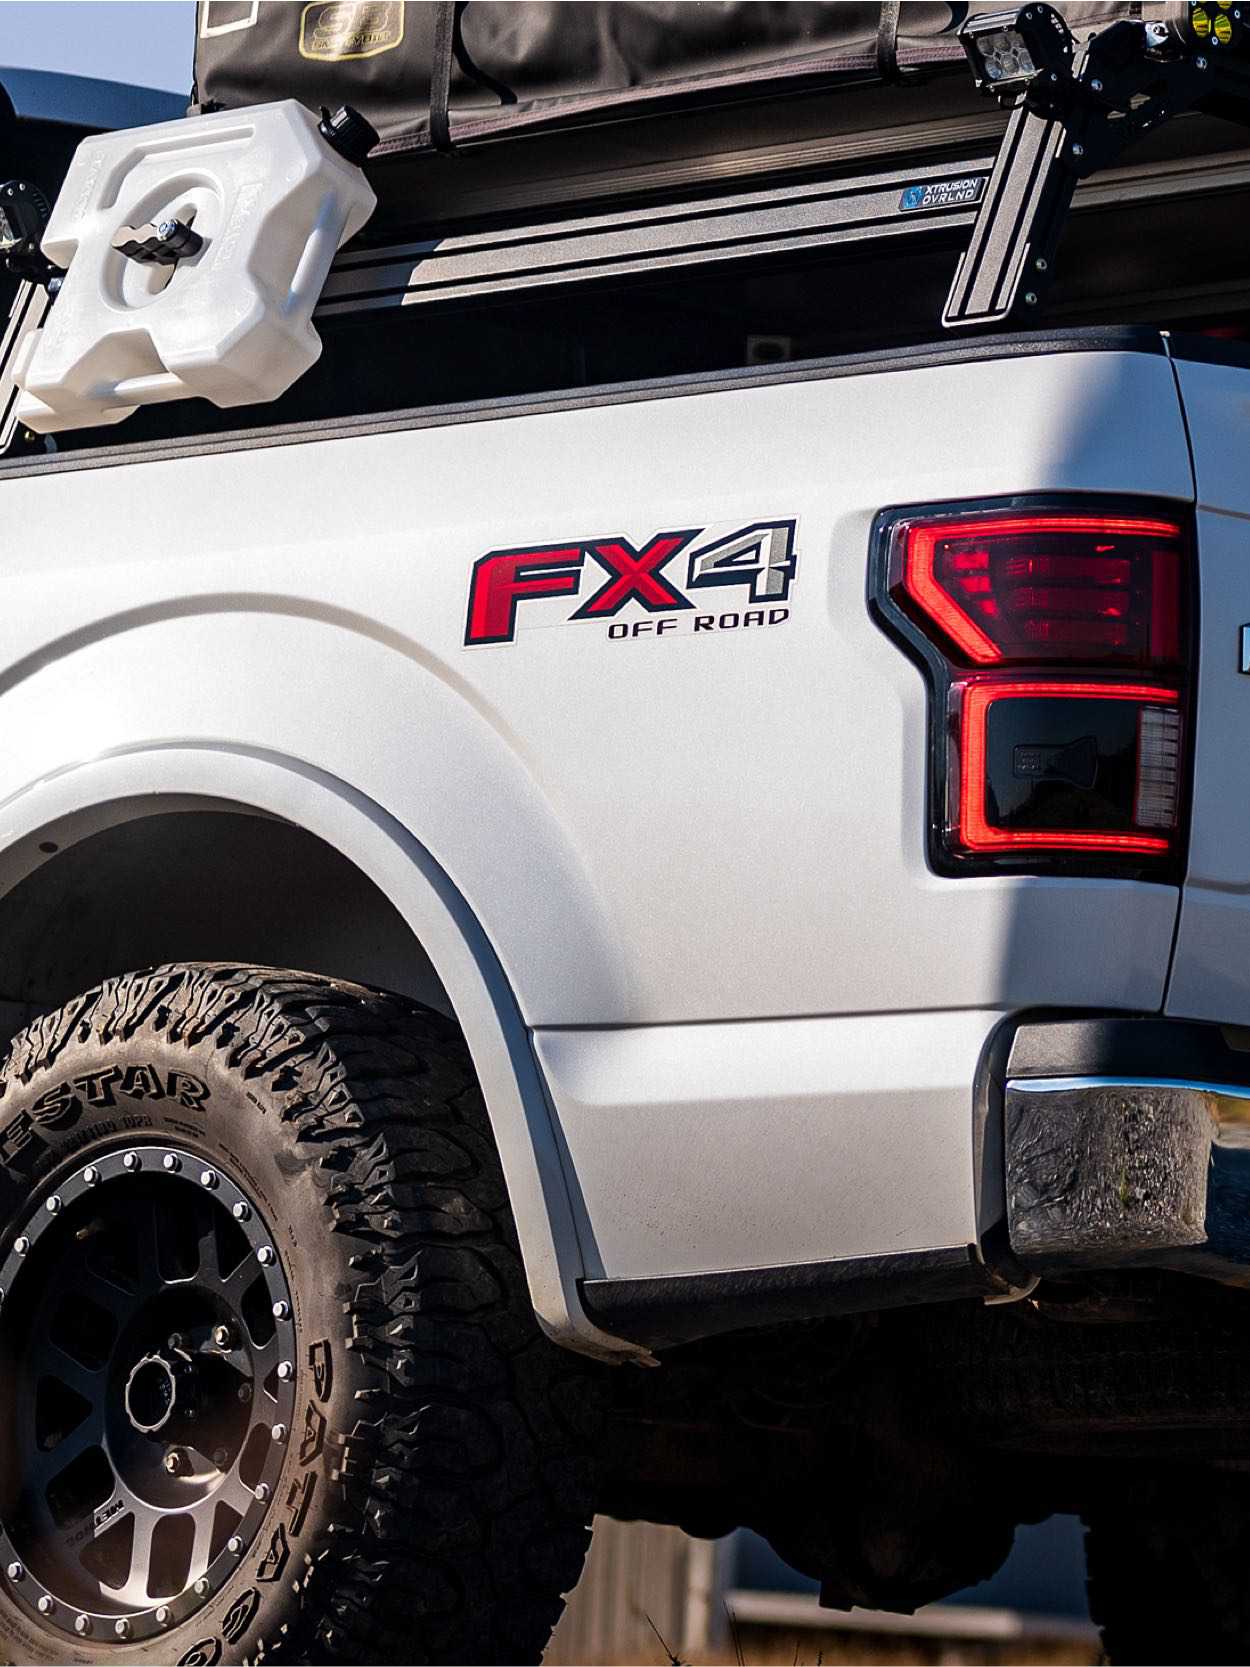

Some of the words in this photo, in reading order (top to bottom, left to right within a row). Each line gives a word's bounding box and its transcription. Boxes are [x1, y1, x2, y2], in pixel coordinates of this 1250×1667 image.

[922, 189, 974, 205] OVRLND
[925, 179, 978, 195] XTRUSION
[464, 519, 797, 646] FX4
[608, 619, 678, 640] OFF
[694, 608, 790, 632] ROAD
